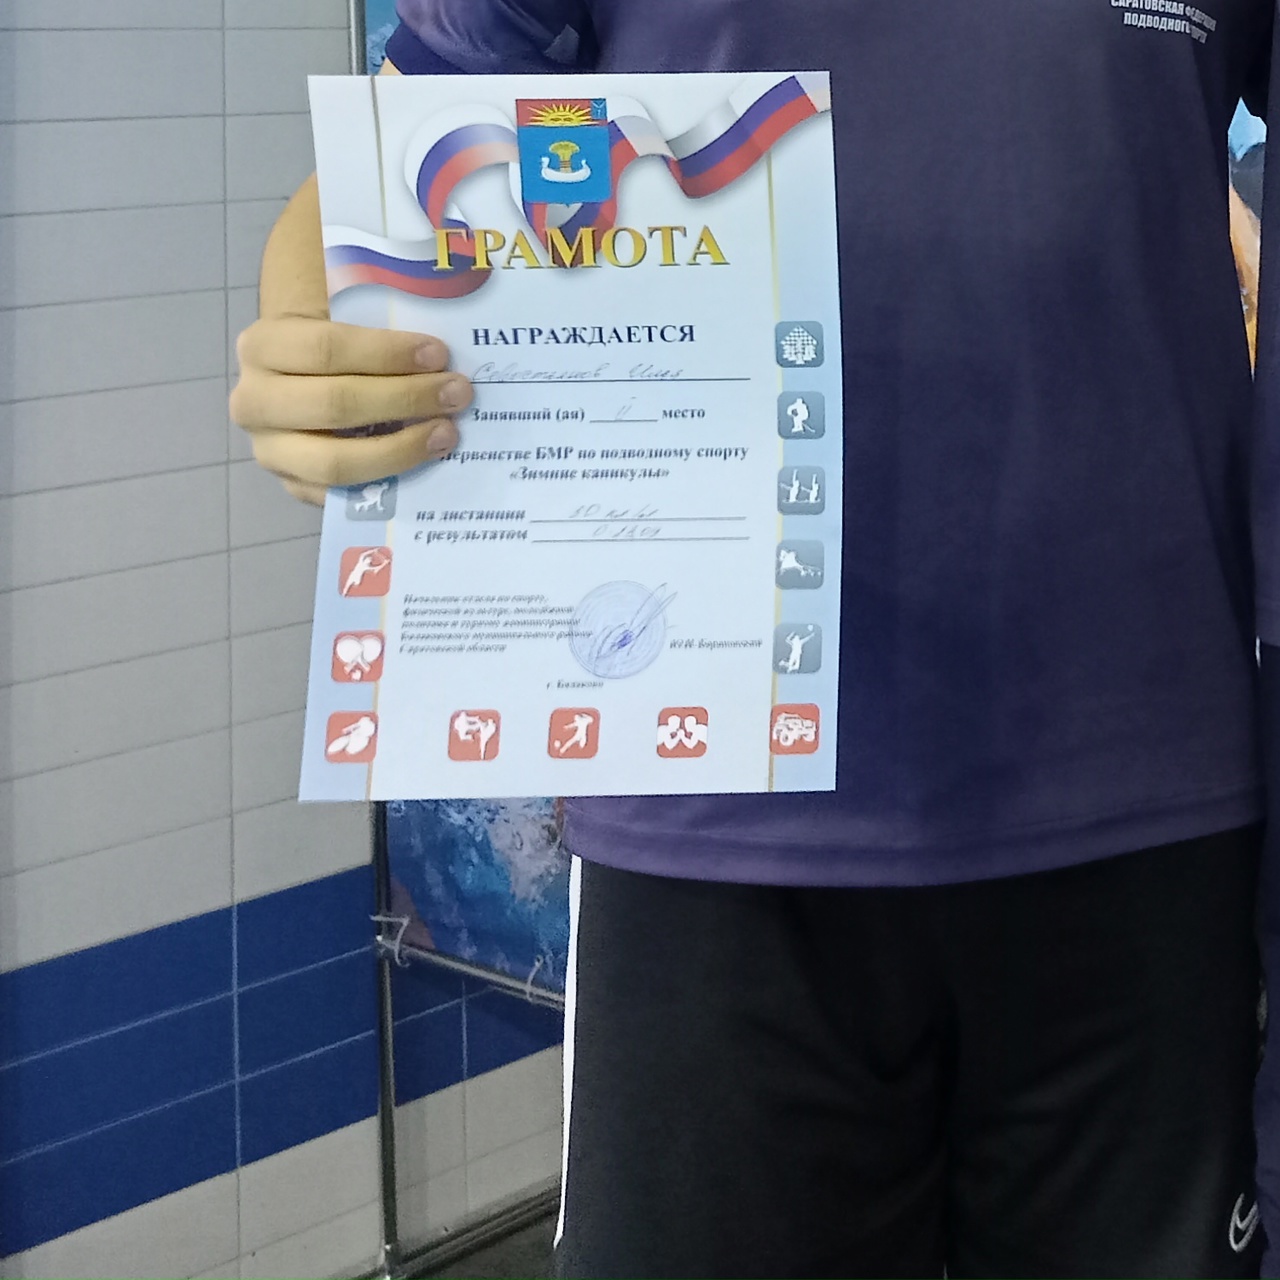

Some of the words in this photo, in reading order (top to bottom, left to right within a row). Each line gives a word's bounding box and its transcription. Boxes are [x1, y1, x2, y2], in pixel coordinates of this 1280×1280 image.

[433, 224, 730, 271] ГРАМОТА
[472, 325, 697, 347] НАГРАЖДАЕТСЯ
[472, 407, 551, 421] Занявший
[555, 407, 585, 422] (ая)
[662, 408, 706, 420] место
[535, 446, 573, 461] БМР
[577, 448, 597, 460] по
[600, 448, 692, 464] подводному
[697, 445, 749, 462] спорту
[416, 509, 436, 522] на
